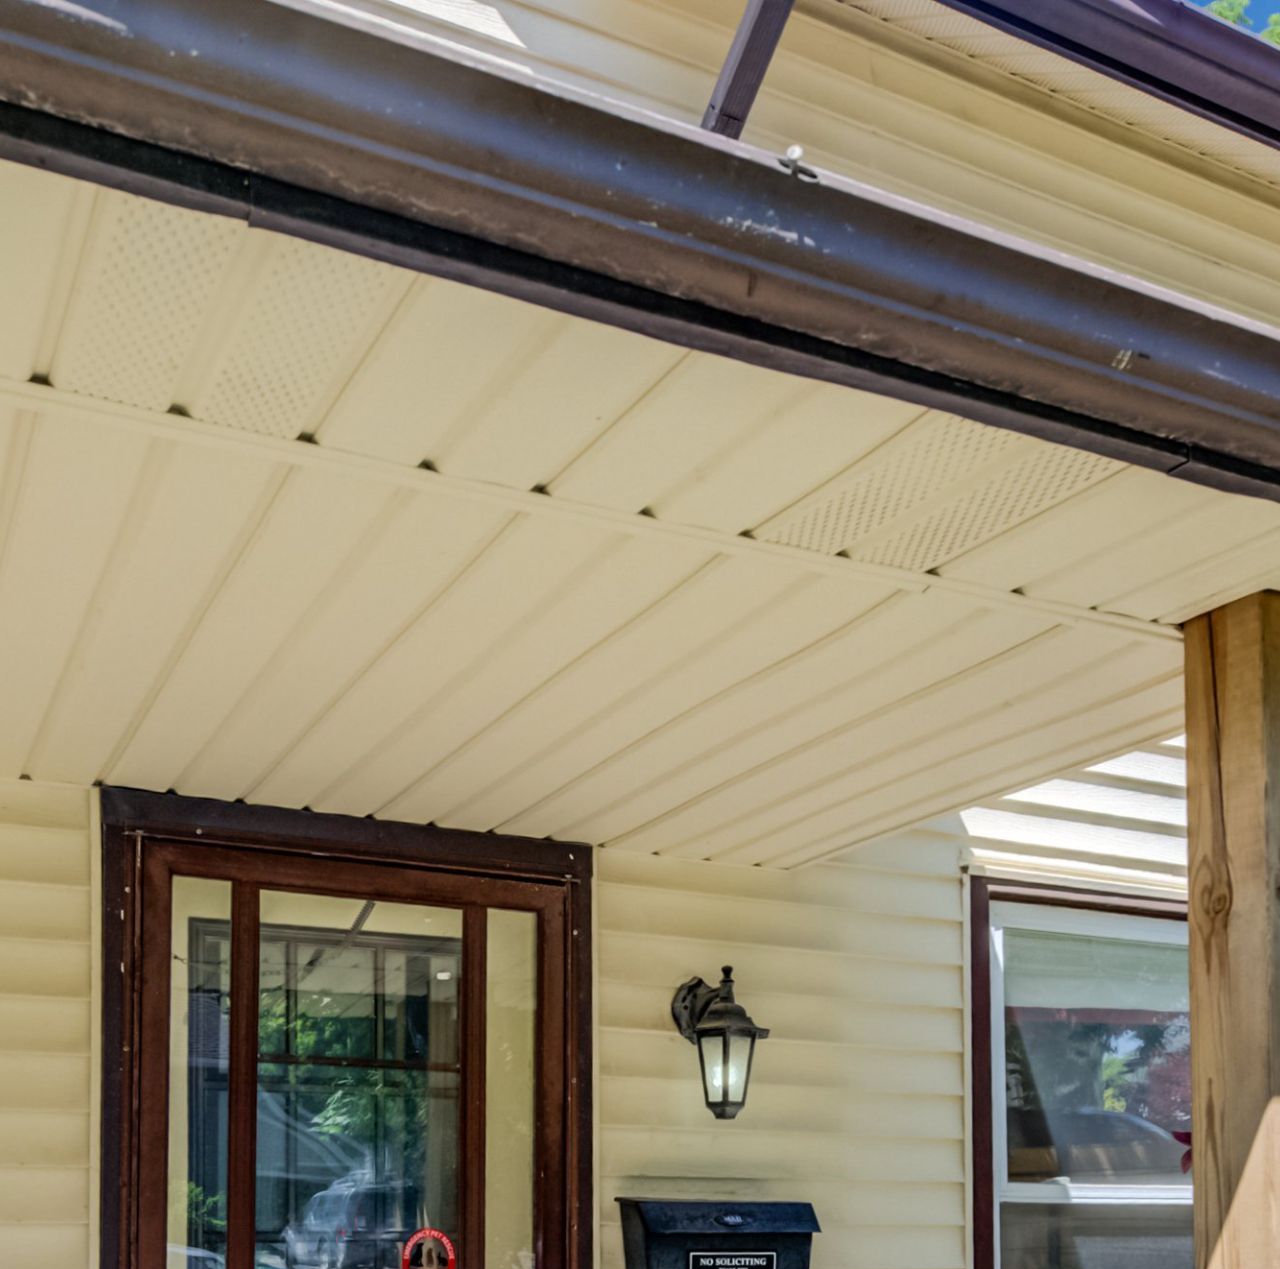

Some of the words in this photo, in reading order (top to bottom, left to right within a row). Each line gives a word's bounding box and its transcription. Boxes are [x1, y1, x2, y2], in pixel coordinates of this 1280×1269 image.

[403, 1230, 429, 1259] EMERGENCY
[430, 1230, 443, 1239] PET
[441, 1236, 455, 1259] RESCUE
[700, 1257, 714, 1266] NO
[715, 1257, 767, 1266] SOLICITING
